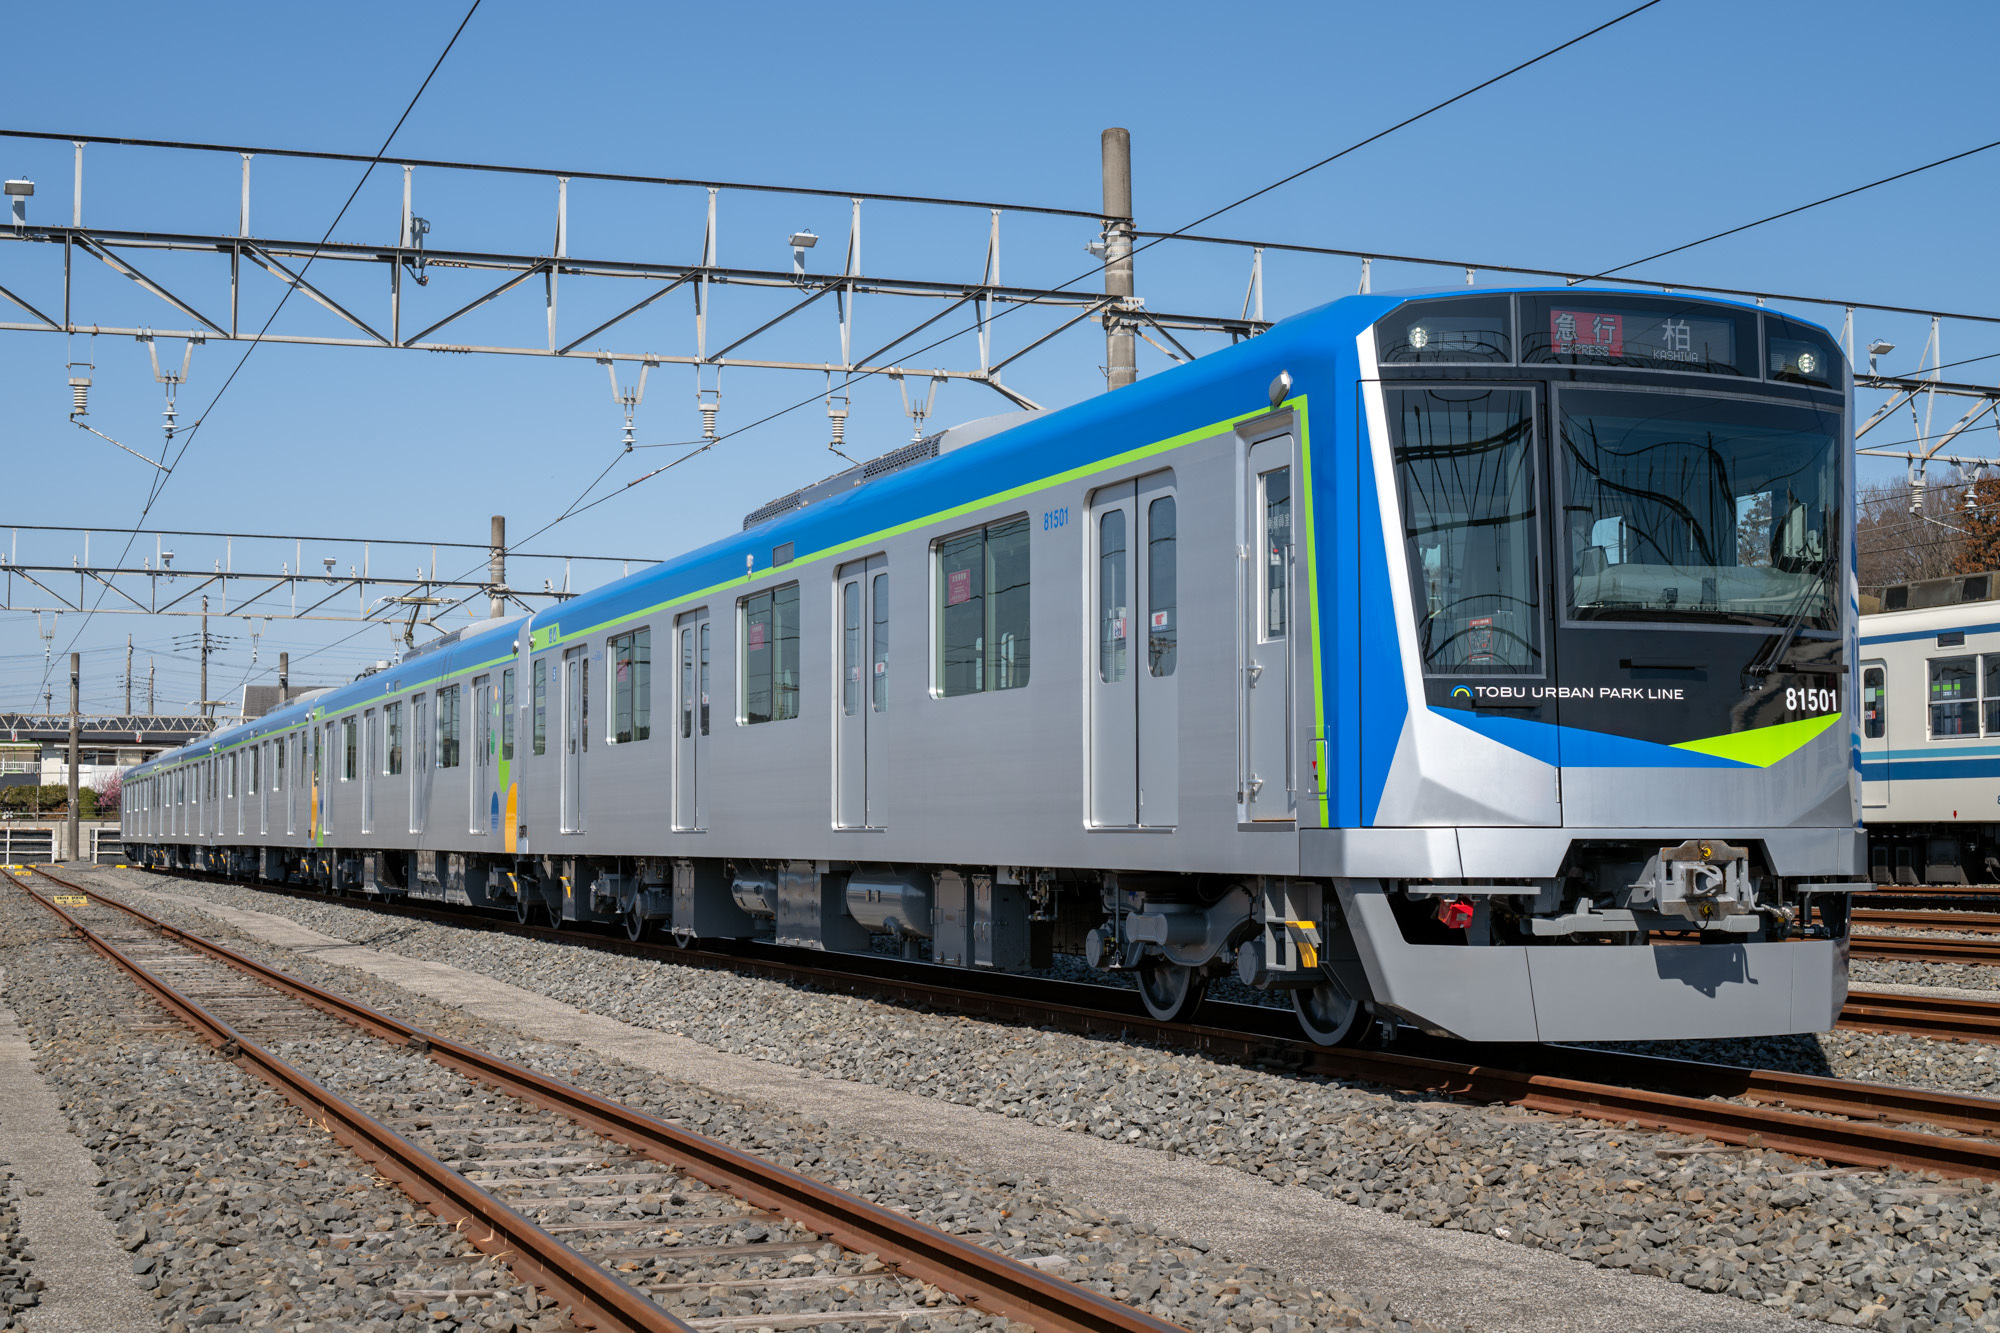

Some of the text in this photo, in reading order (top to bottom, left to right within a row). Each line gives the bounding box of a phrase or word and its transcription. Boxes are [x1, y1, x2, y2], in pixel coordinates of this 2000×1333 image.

[1554, 313, 1616, 345] 急行
[1662, 318, 1691, 352] 柏
[1560, 343, 1610, 357] EXPRESS
[1653, 350, 1699, 363] KASHIWA
[1044, 506, 1069, 531] 81501
[1475, 686, 1684, 700] TOBU URBAN PARK LINE
[1786, 687, 1837, 712] 81501
